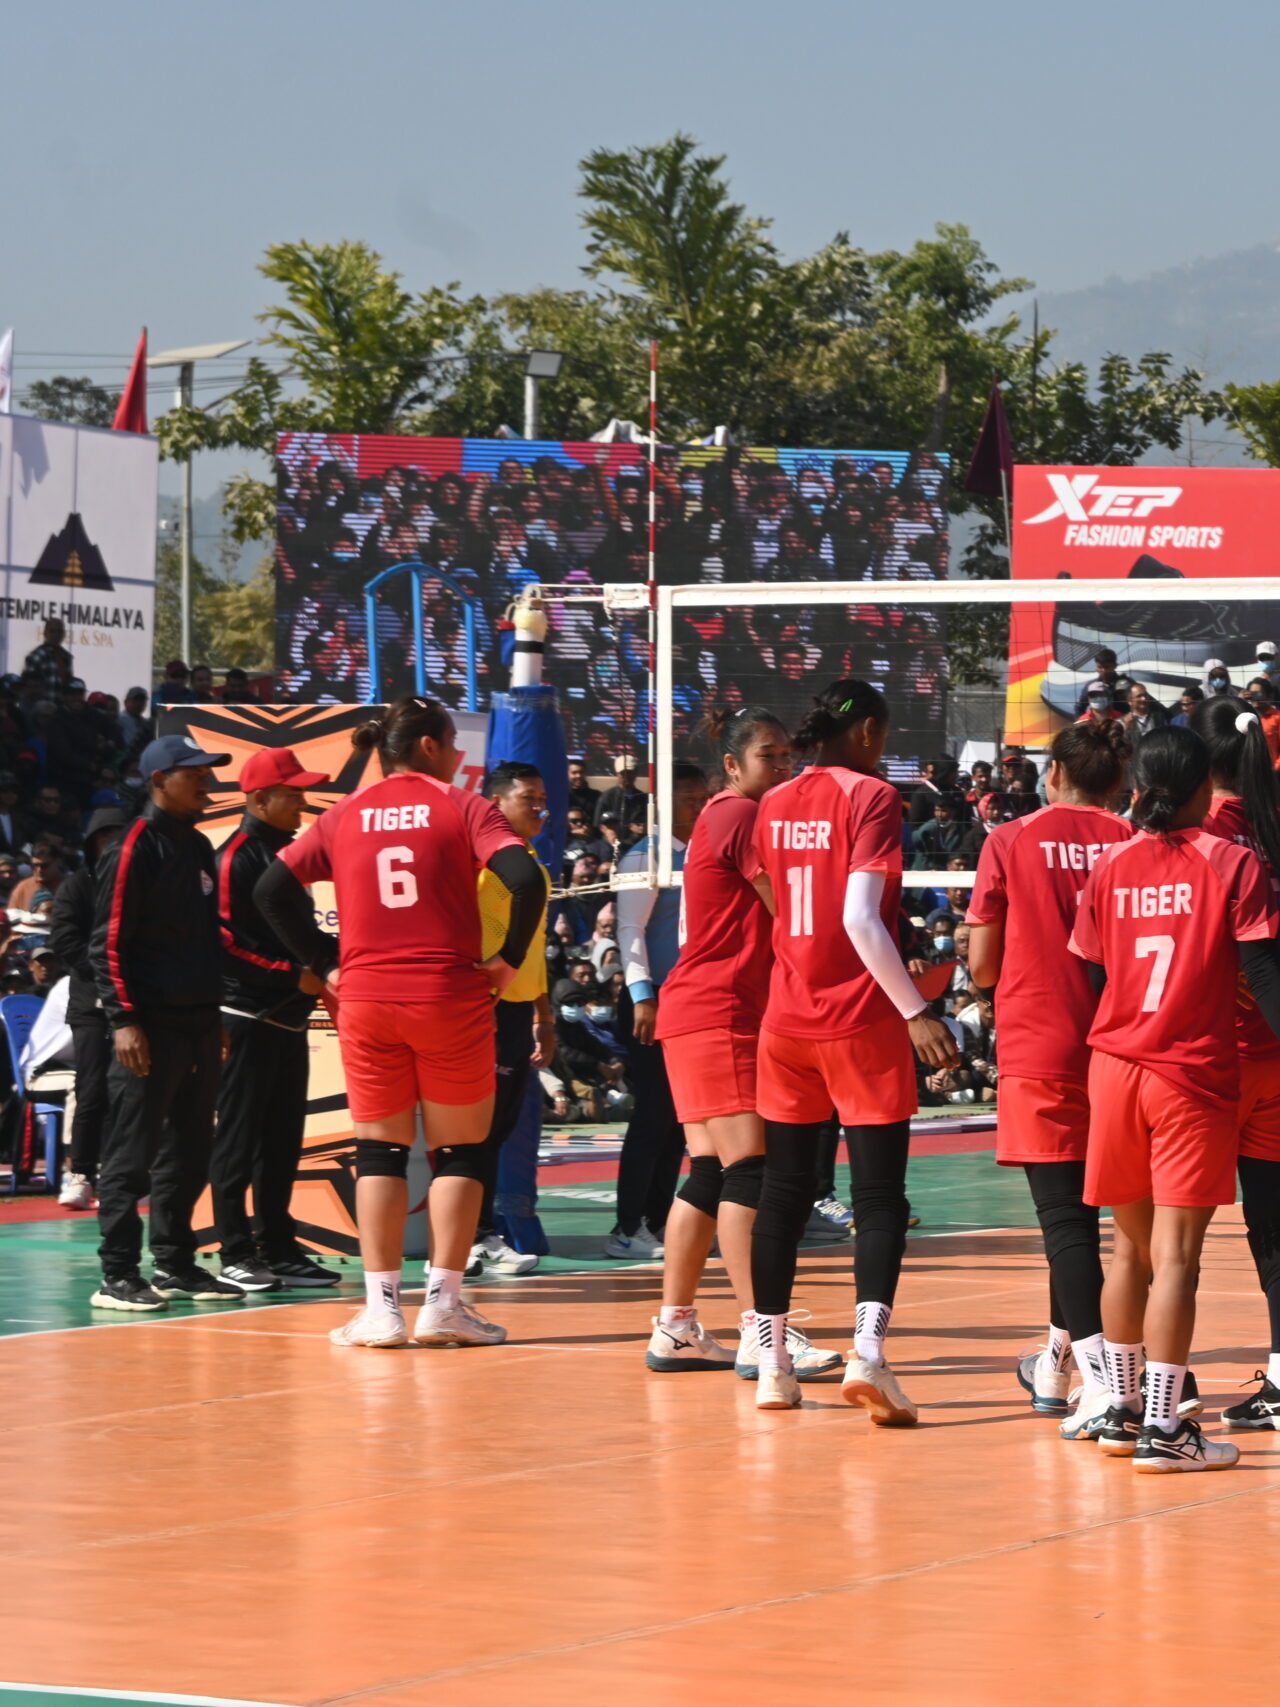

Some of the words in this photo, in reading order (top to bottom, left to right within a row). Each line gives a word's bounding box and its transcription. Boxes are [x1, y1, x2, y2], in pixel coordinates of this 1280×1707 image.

[1021, 474, 1183, 524] XTEP
[1064, 525, 1146, 547] FASHION
[1147, 526, 1224, 549] SPORTS
[60, 602, 145, 630] HIMALAYA
[360, 804, 431, 833] TIGER
[770, 820, 832, 850] TIGER
[1039, 841, 1113, 871] TIGE
[376, 845, 419, 909] 6
[787, 865, 813, 937] 11
[1114, 883, 1193, 919] TIGER
[1135, 935, 1176, 1012] 7
